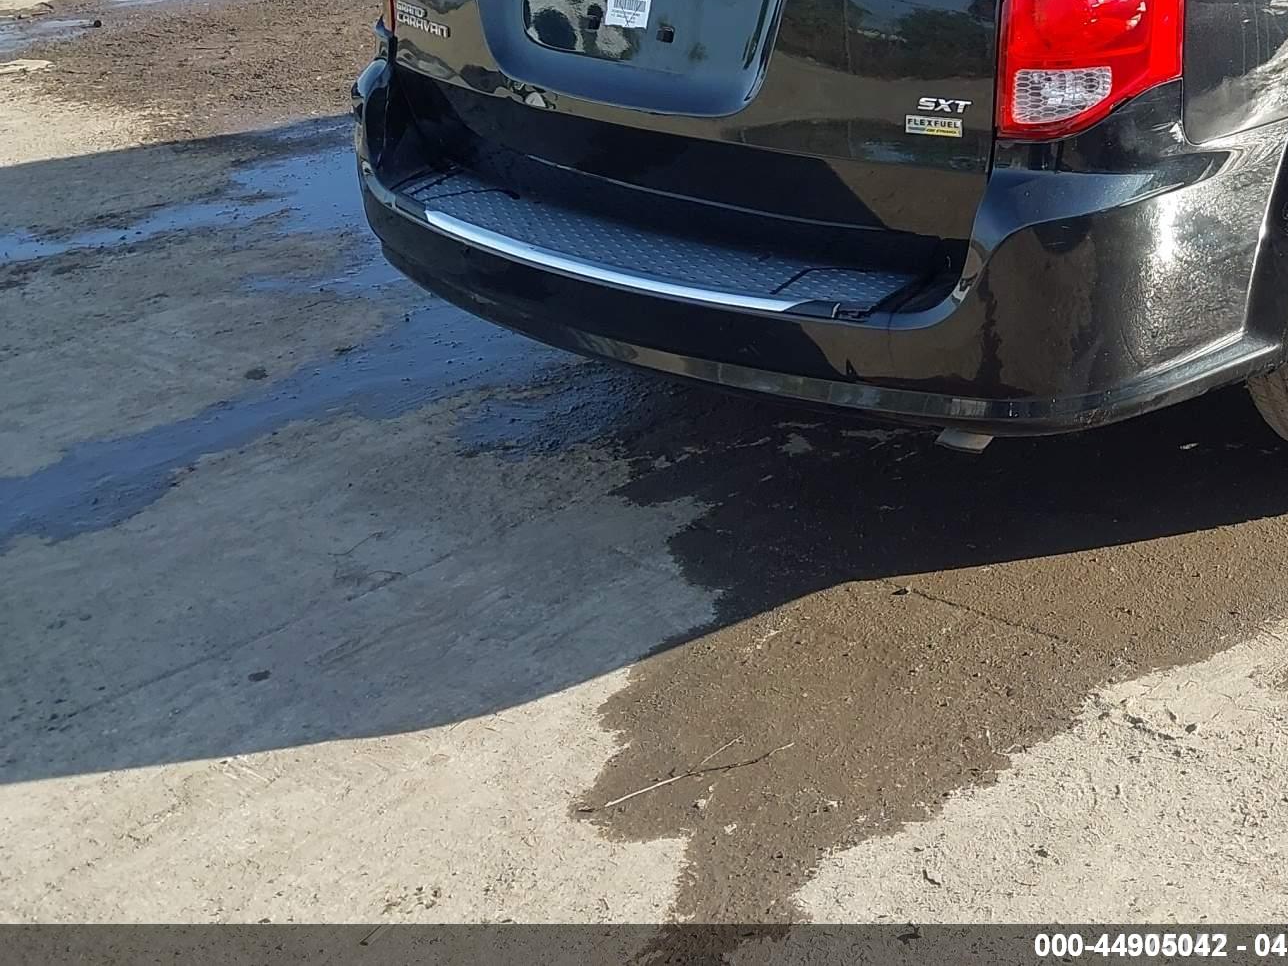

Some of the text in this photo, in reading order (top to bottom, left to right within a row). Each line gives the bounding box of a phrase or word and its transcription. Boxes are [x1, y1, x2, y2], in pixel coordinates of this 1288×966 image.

[396, 1, 426, 18] GRAND
[396, 12, 449, 38] CARAVAN
[917, 97, 972, 113] SXT
[907, 118, 960, 129] FLEXFUEL
